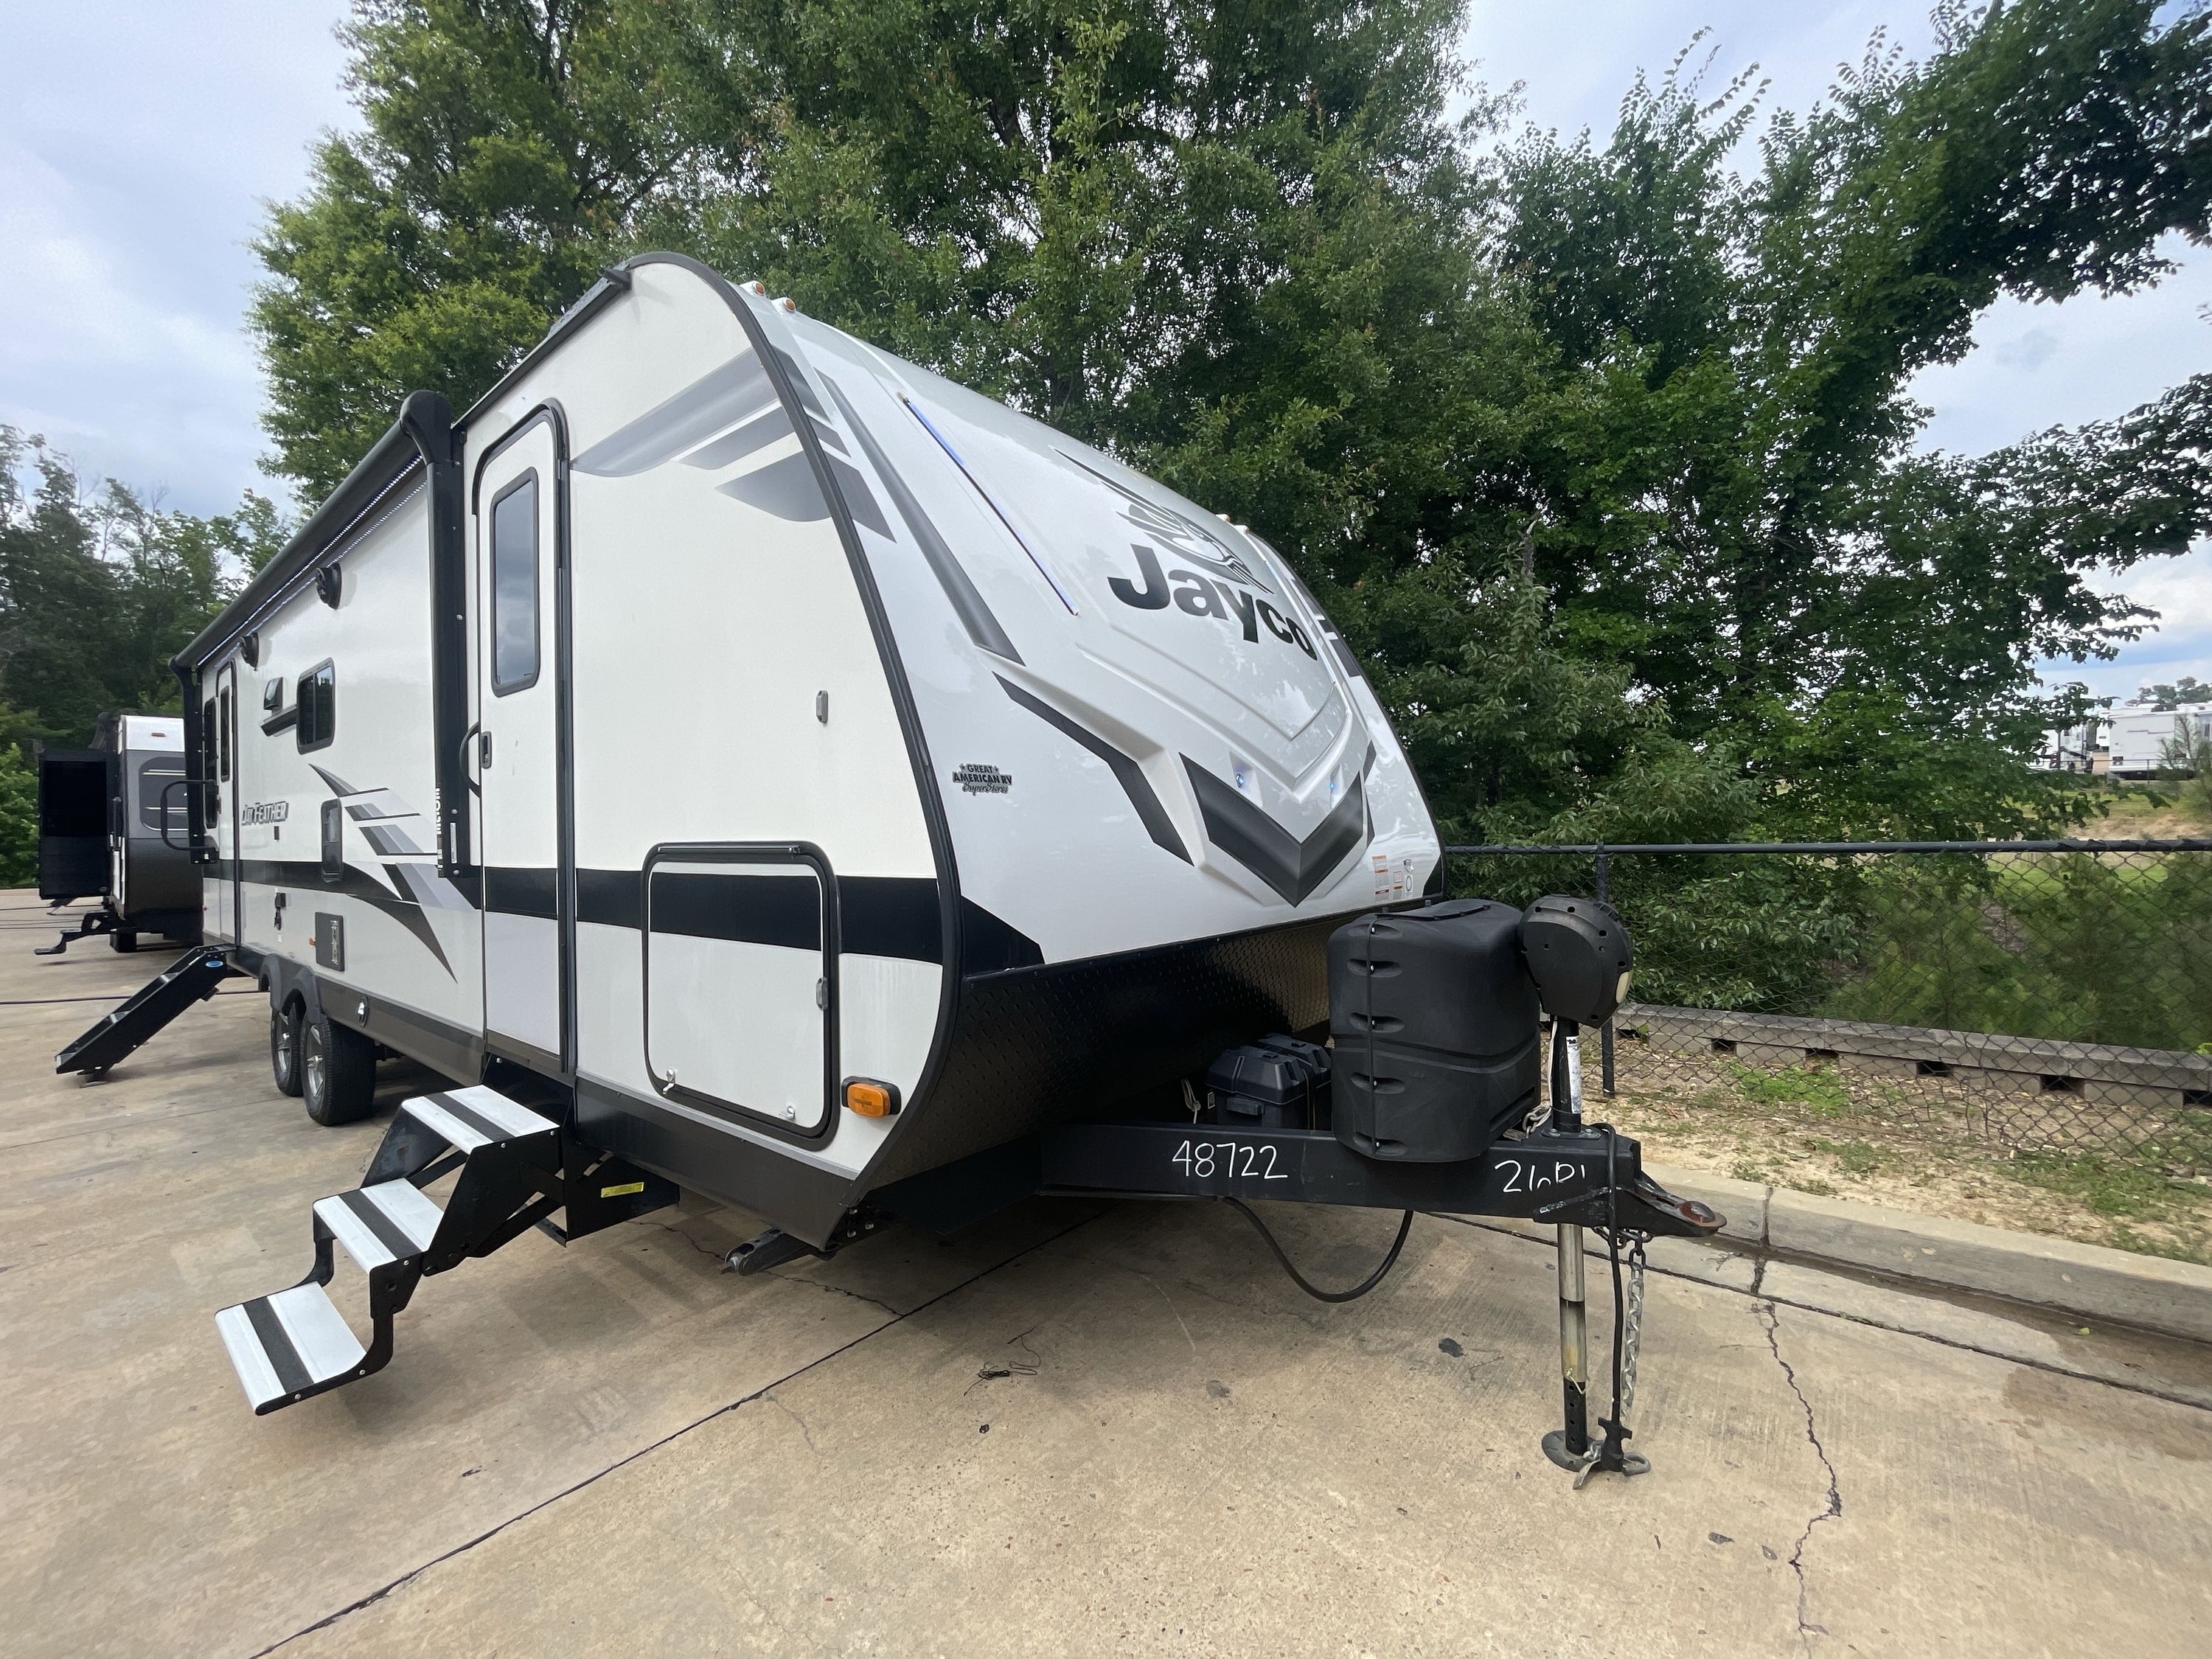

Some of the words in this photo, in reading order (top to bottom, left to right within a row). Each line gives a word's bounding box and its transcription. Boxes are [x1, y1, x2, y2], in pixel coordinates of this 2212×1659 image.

[1107, 543, 1318, 661] Jayco
[953, 773, 1001, 784] AMERICAN
[1001, 775, 1012, 785] RV
[967, 765, 993, 773] GREAT
[1172, 1140, 1289, 1180] 48722
